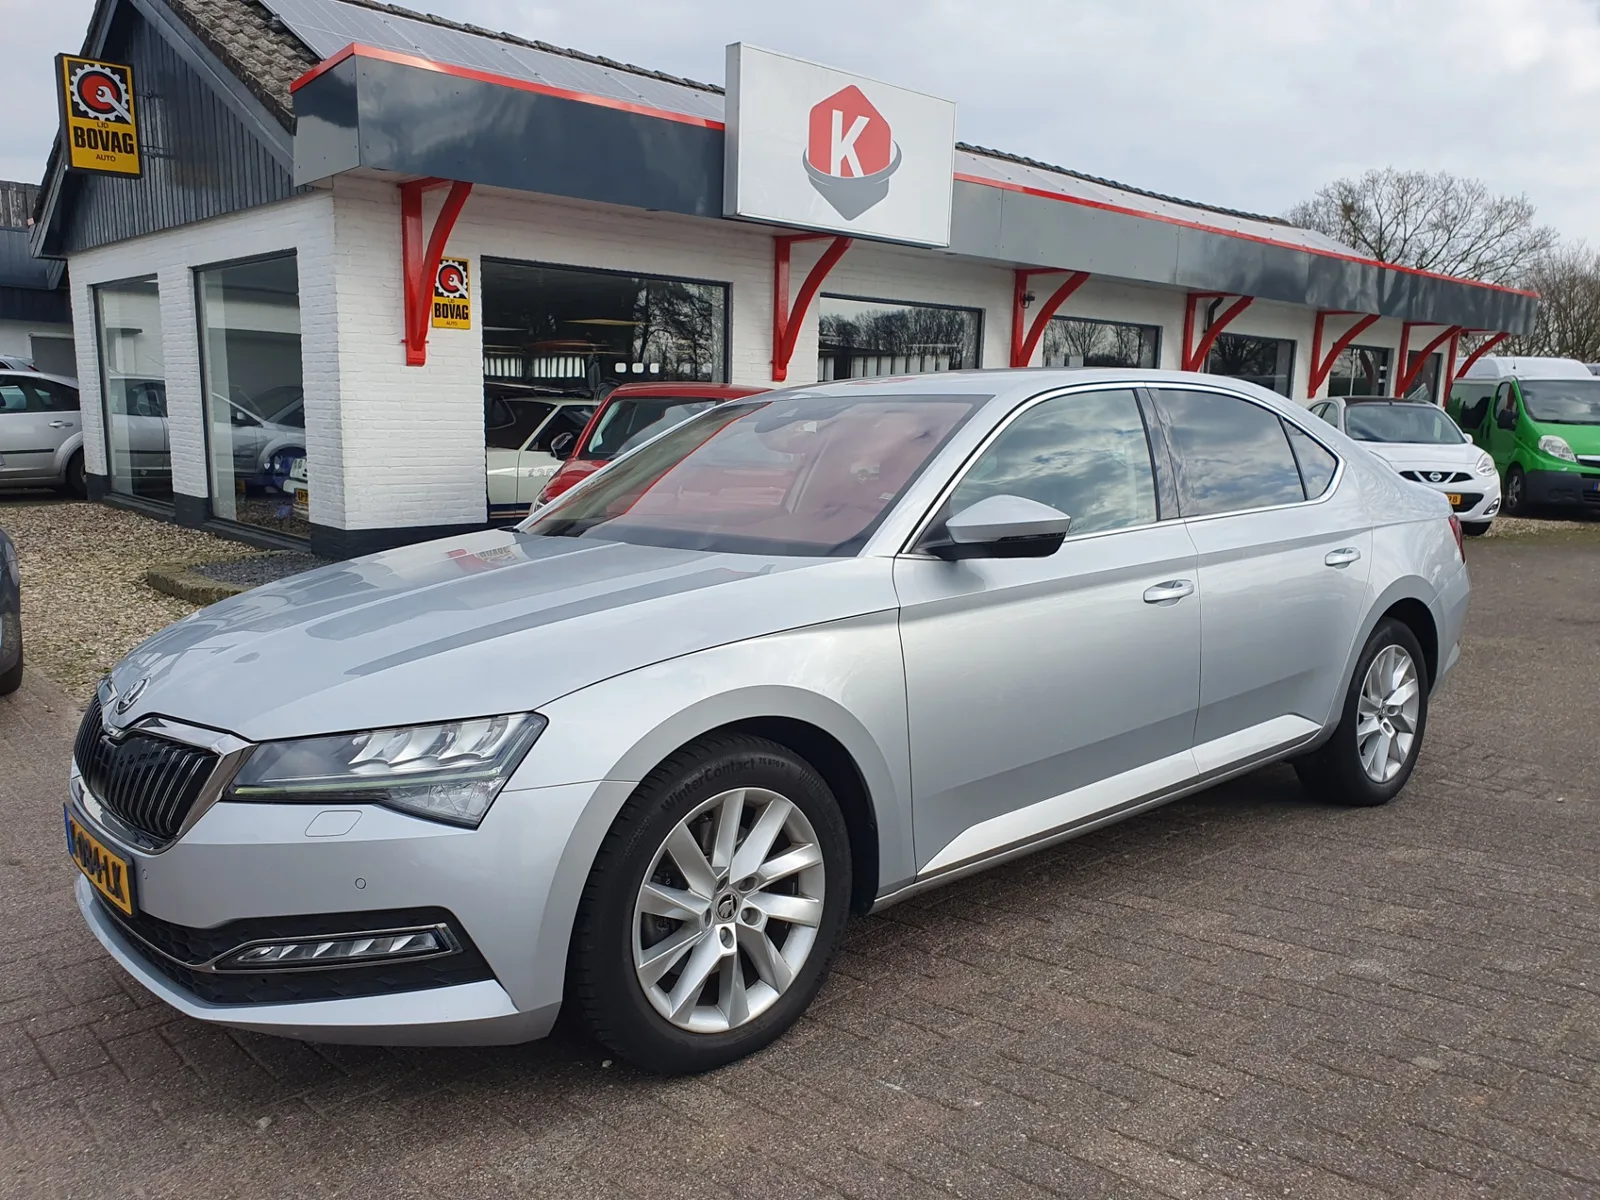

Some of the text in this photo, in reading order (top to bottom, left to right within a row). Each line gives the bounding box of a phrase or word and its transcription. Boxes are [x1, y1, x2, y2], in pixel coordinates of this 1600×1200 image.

[96, 121, 109, 129] LID
[73, 126, 135, 155] BOVAG
[830, 109, 871, 178] K
[95, 154, 117, 162] AUTO
[434, 302, 469, 320] BOVAG
[660, 757, 756, 812] WinterContact
